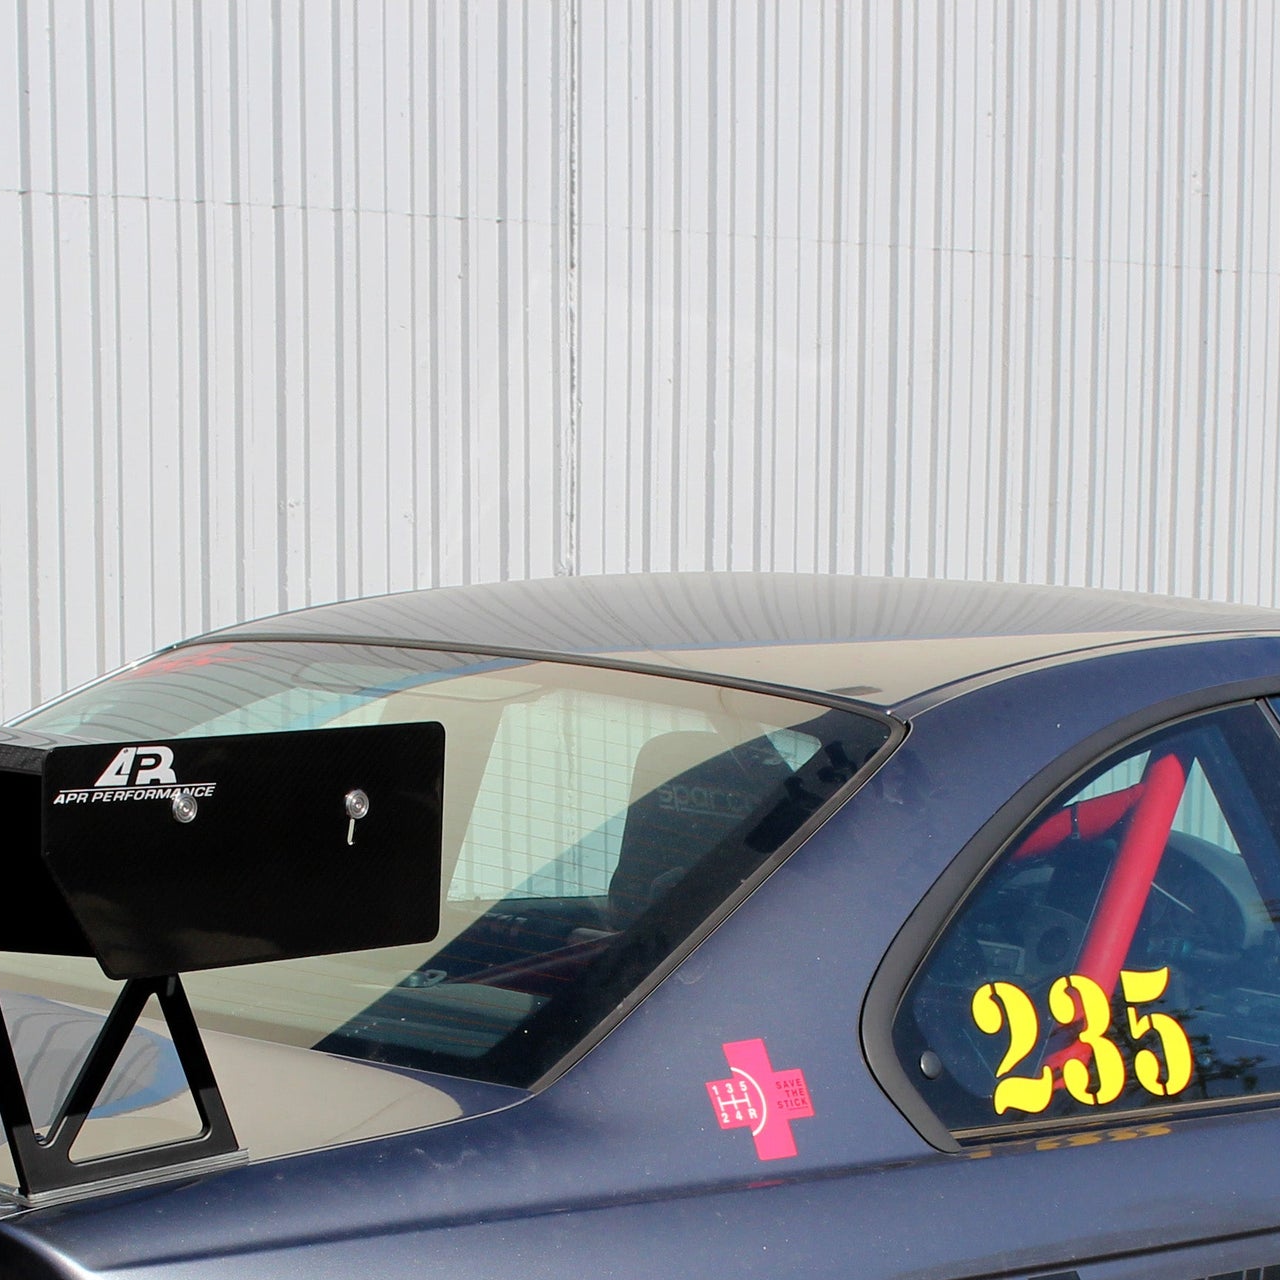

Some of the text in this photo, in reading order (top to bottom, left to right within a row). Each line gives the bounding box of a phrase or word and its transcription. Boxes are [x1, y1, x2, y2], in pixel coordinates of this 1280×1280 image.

[94, 746, 177, 786] APR
[53, 786, 216, 804] APR PERFORMANCE
[971, 966, 1194, 1116] 235
[775, 1078, 803, 1090] SAVE
[785, 1088, 805, 1097] THE
[777, 1098, 808, 1109] STICK
